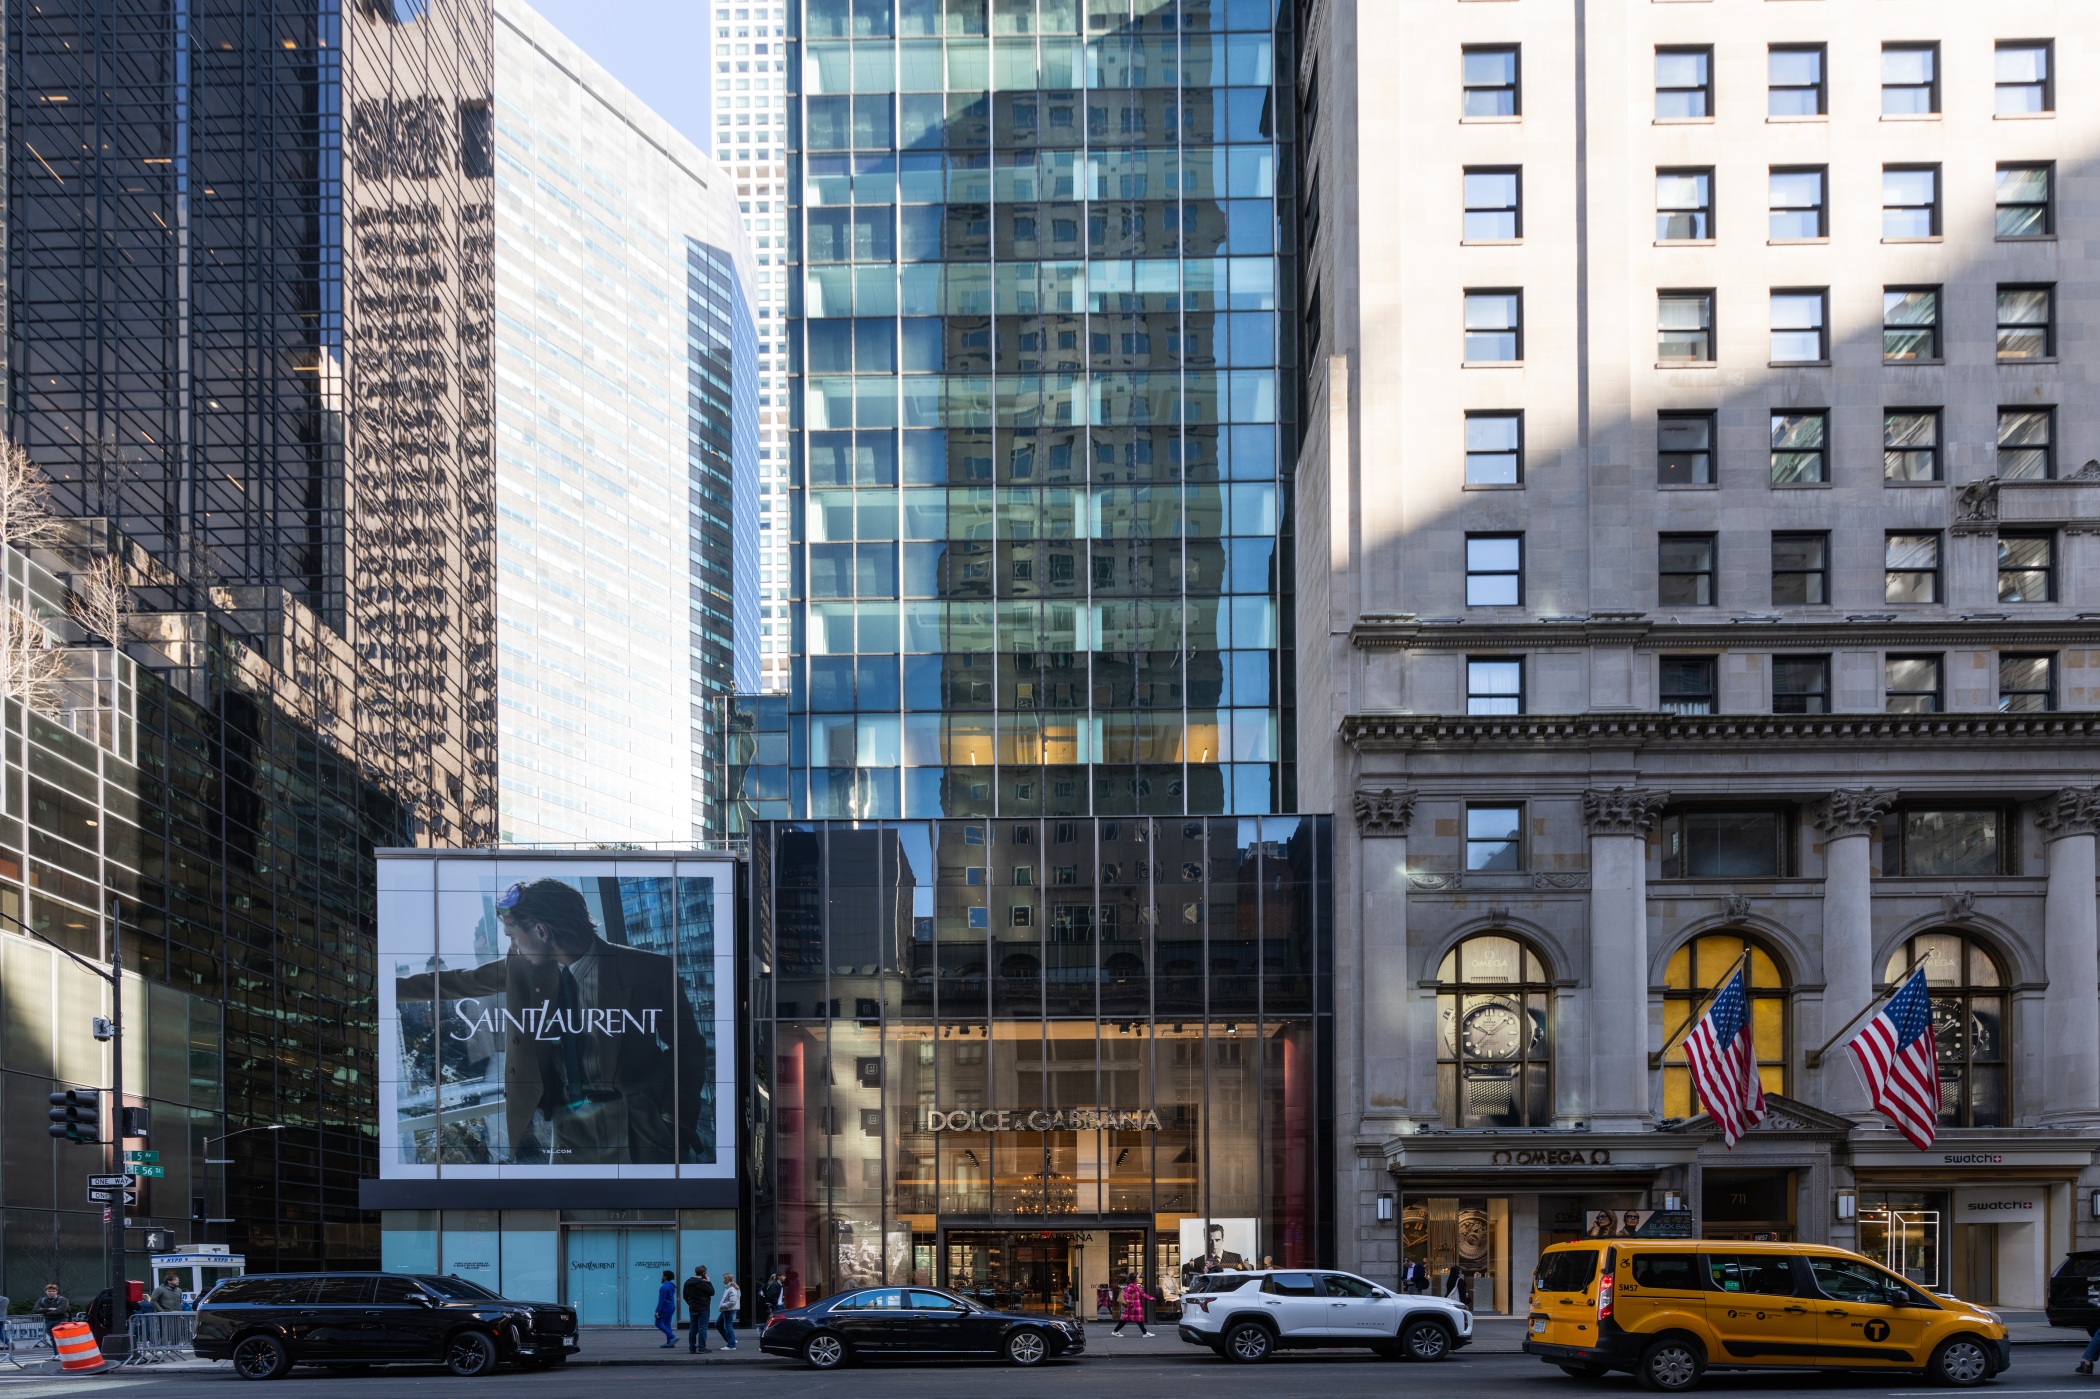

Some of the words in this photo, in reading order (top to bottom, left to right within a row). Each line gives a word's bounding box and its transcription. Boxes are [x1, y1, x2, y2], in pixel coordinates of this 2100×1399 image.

[927, 1109, 1010, 1132] DOLCE
[1028, 1109, 1163, 1131] GABBANA
[137, 1152, 142, 1161] 5
[1516, 1150, 1586, 1165] OMEGA
[1944, 1154, 1993, 1163] swatch
[134, 1166, 139, 1174] E
[142, 1166, 153, 1176] 56
[1730, 1193, 1746, 1205] 711
[1967, 1201, 2022, 1210] swatch
[1619, 1284, 1638, 1292] 5M57
